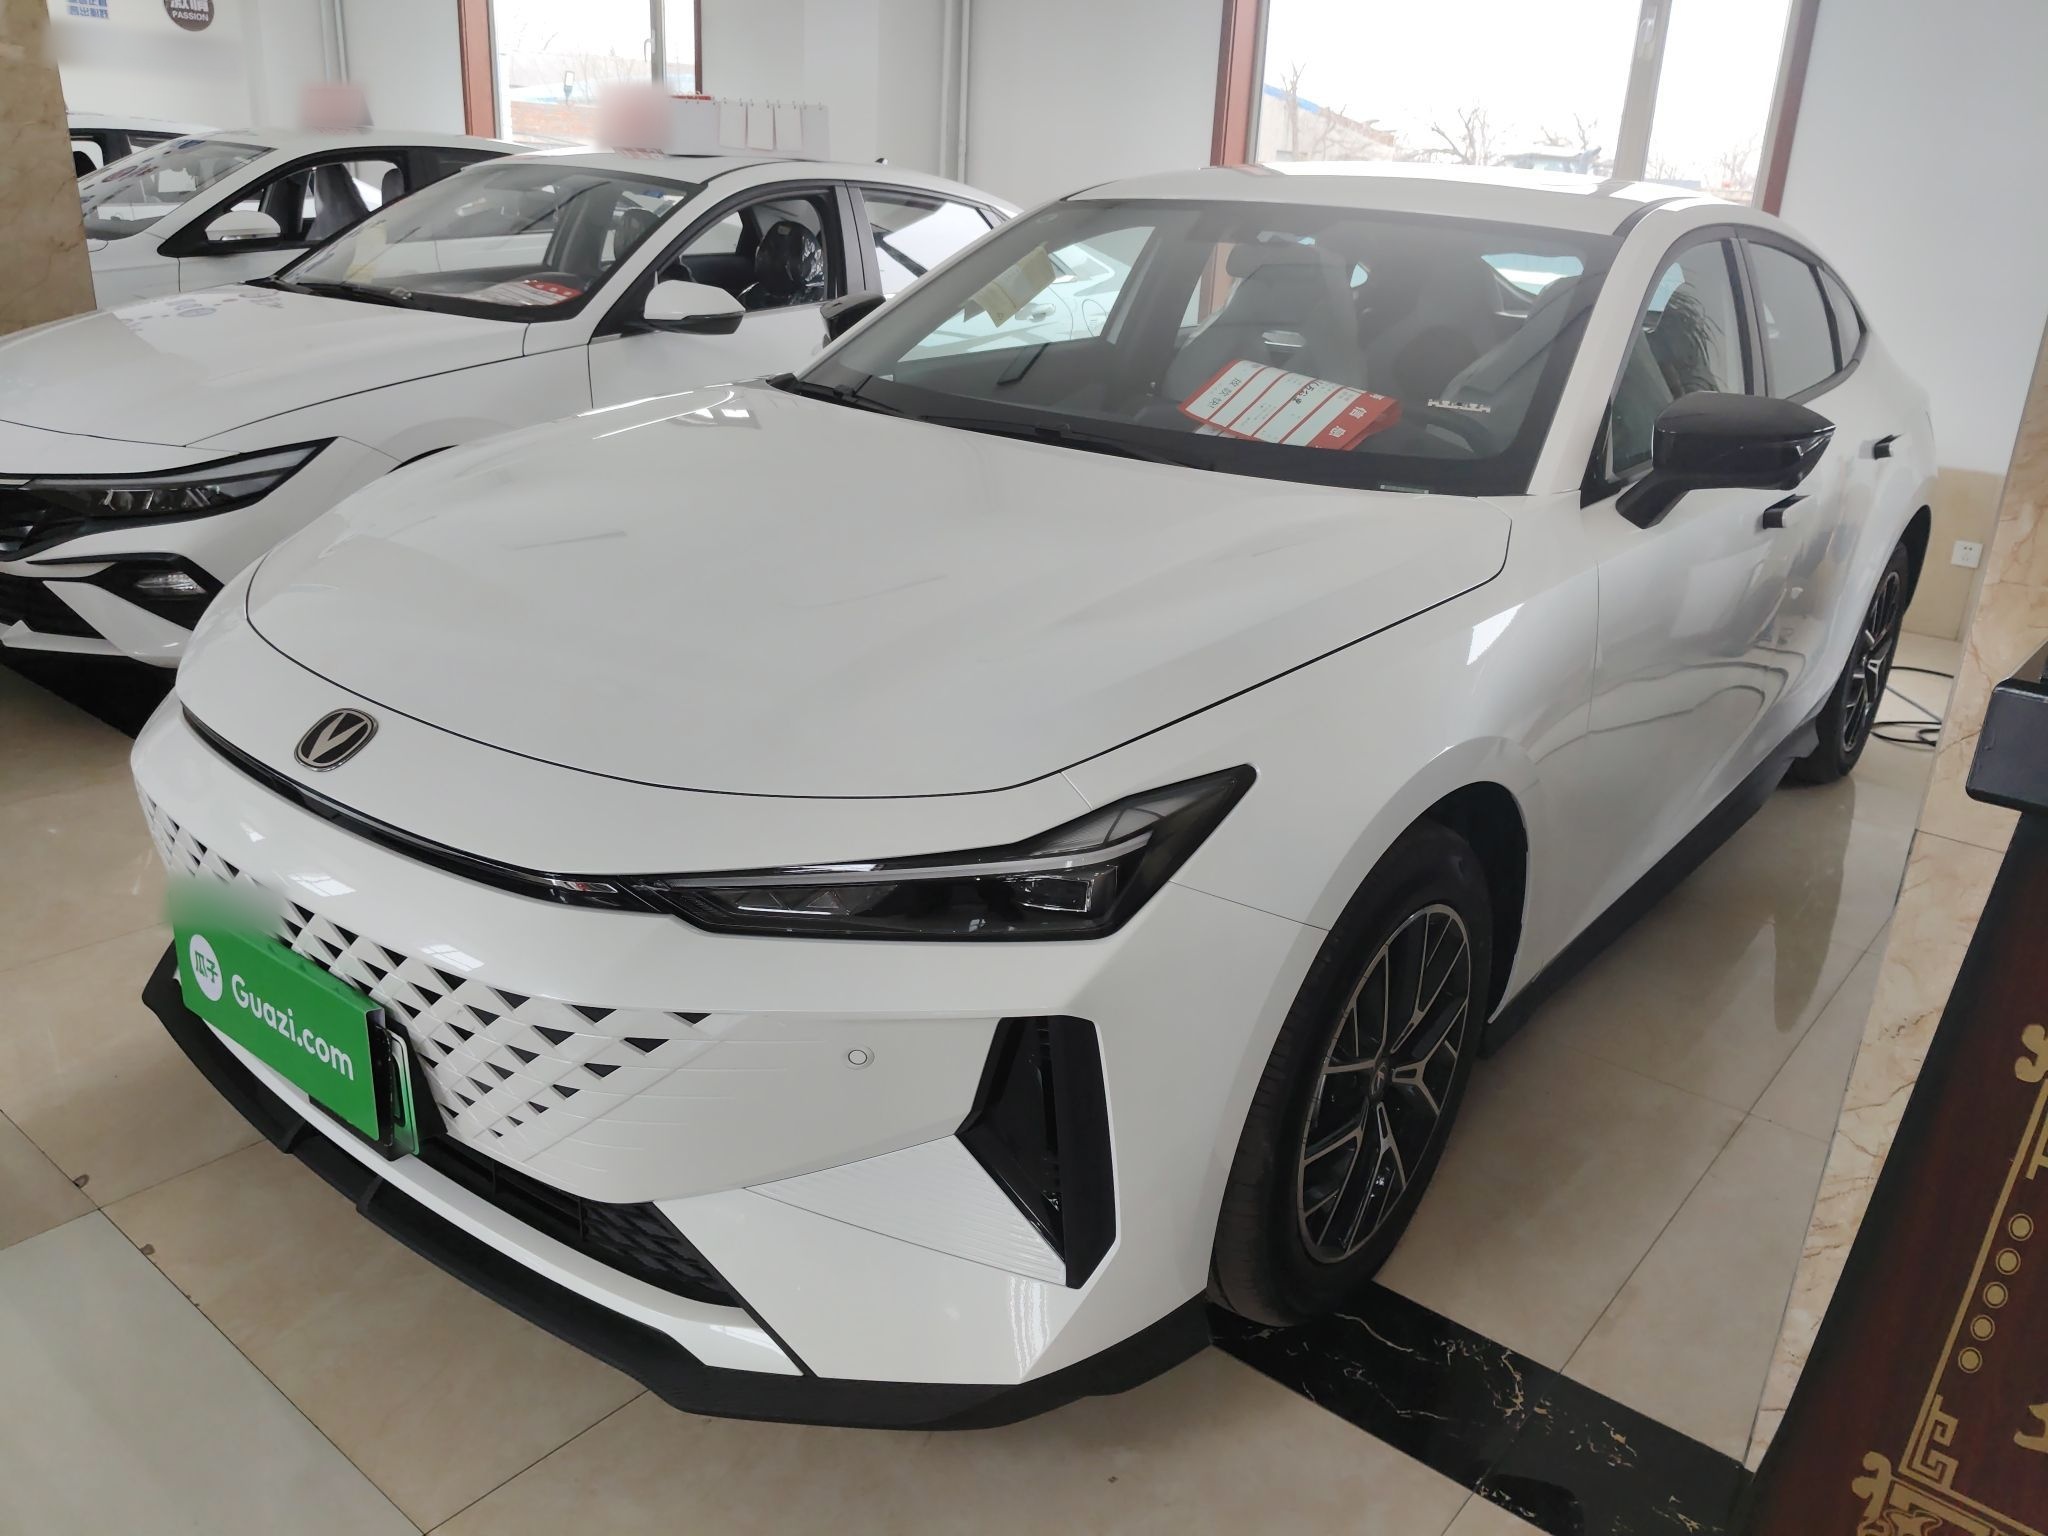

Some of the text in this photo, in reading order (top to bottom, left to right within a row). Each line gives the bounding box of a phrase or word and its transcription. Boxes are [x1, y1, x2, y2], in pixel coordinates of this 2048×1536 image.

[171, 10, 209, 22] PASSION
[193, 949, 219, 985] 瓜子
[230, 972, 356, 1082] Guazi.com
